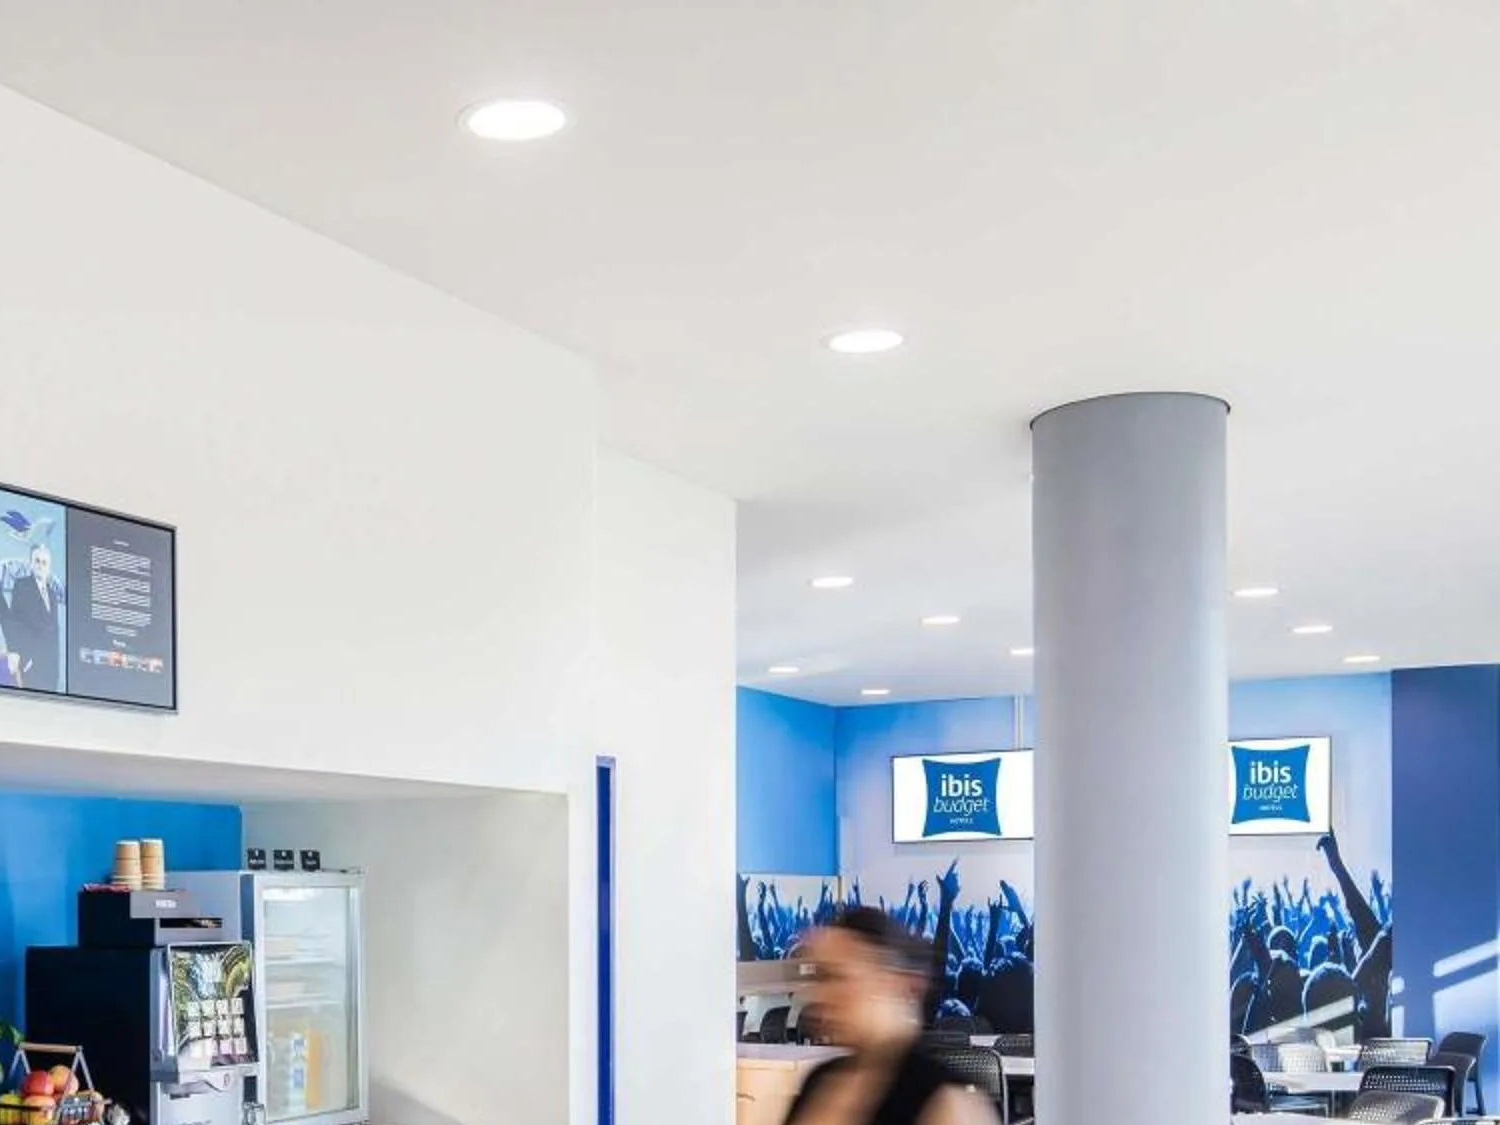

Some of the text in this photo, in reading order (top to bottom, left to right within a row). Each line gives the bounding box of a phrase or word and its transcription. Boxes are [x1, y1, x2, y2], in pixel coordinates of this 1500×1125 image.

[1250, 760, 1292, 784] ibis
[941, 773, 983, 797] ibis
[1243, 783, 1299, 803] budget
[933, 796, 990, 816] budget
